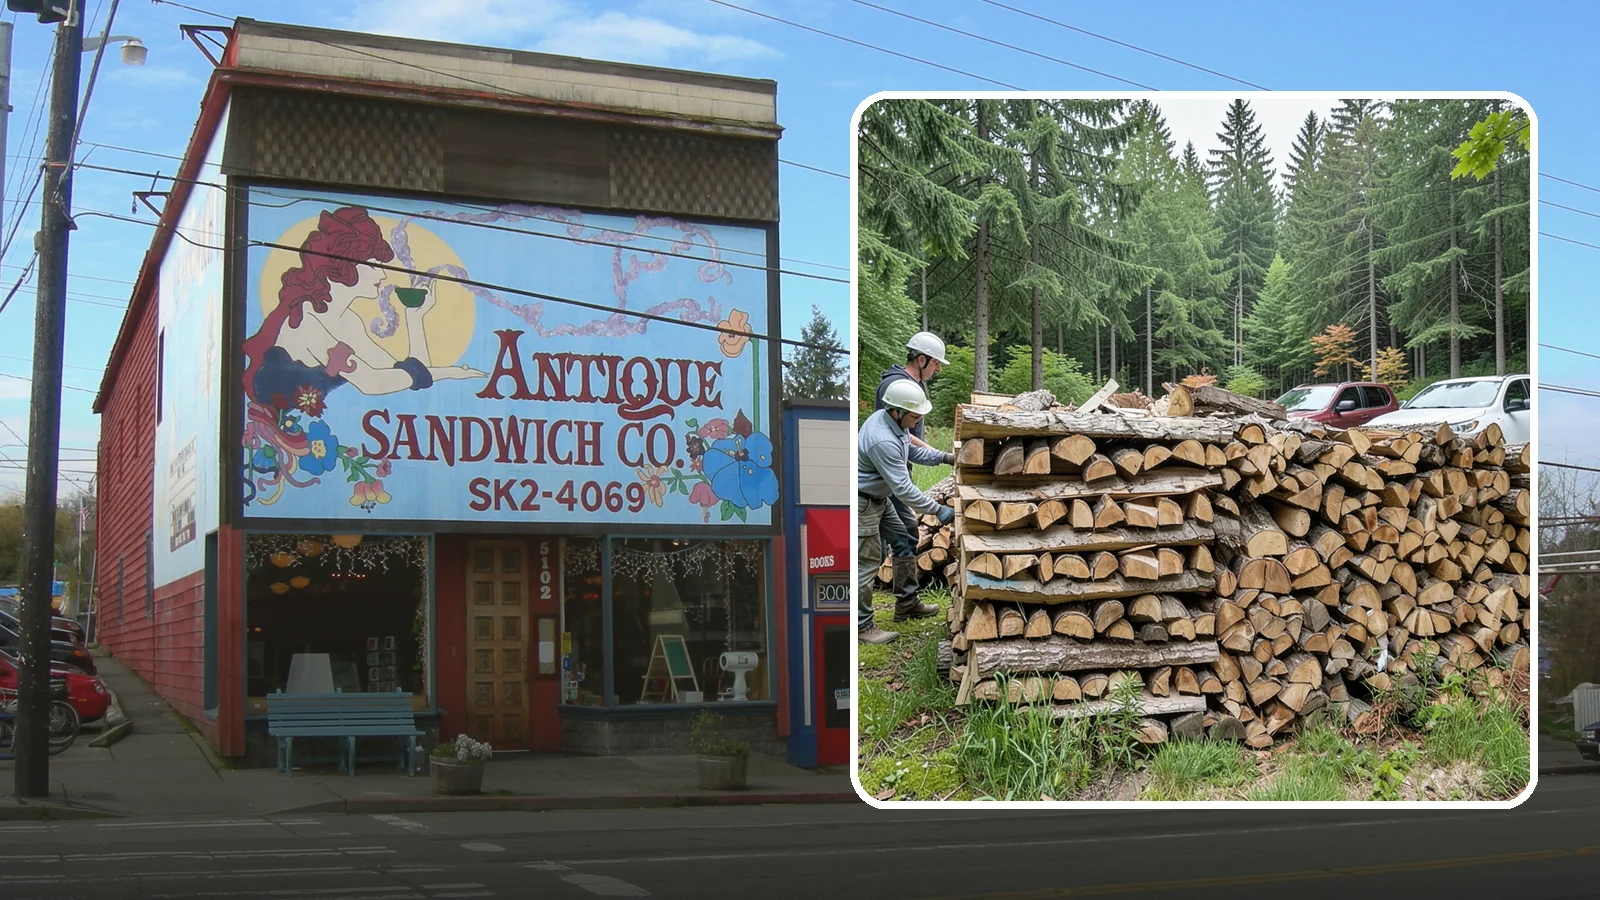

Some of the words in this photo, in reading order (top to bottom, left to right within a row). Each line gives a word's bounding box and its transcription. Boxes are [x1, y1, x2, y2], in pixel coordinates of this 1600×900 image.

[476, 329, 723, 421] ANTIQUE
[362, 408, 604, 467] SANDWICH
[617, 422, 685, 468] CO.
[468, 477, 646, 513] SK2-4069
[539, 541, 552, 600] 5102
[809, 555, 835, 569] BOOKS
